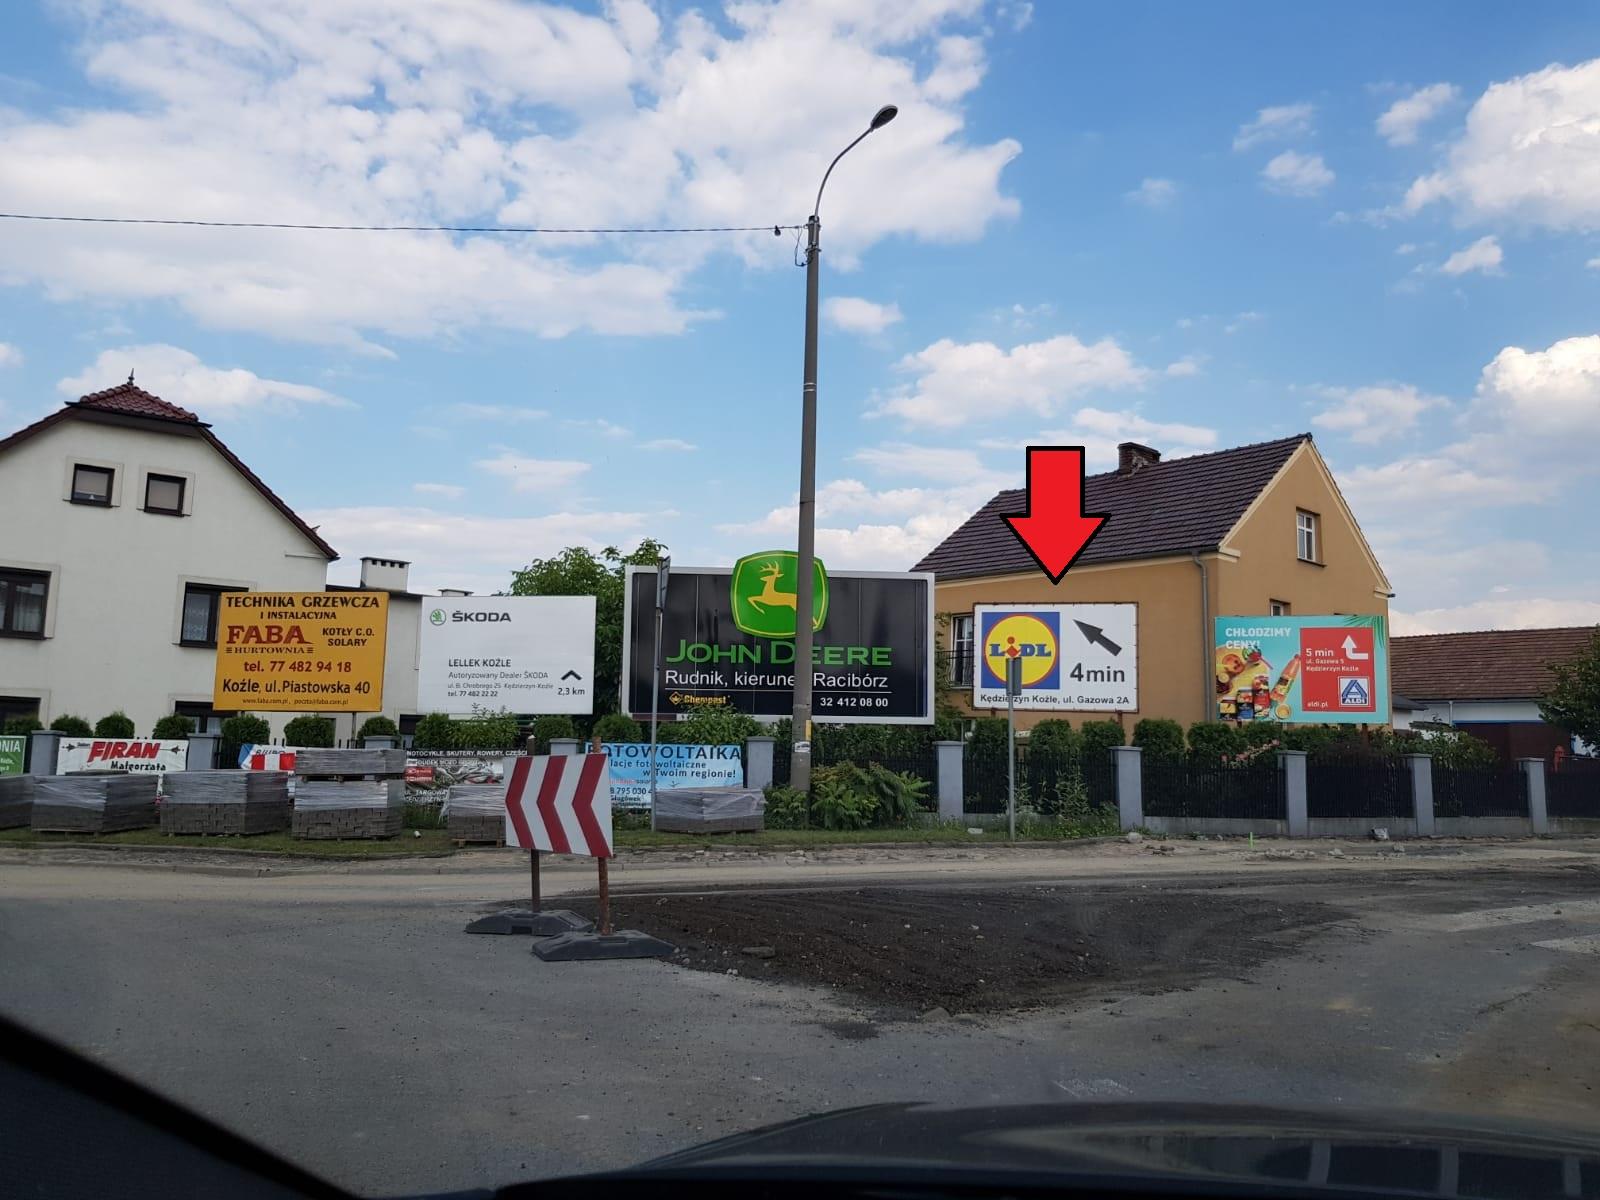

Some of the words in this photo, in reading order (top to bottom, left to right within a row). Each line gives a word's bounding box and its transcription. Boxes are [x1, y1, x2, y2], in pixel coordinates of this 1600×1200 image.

[227, 597, 295, 607] TECHNIKA
[302, 597, 379, 608] GRZEWCZA
[452, 611, 511, 622] ŠKODA
[226, 625, 316, 644] FABA
[322, 628, 352, 636] KOTŁY
[356, 628, 375, 637] C.O.
[1225, 628, 1291, 637] CHŁODZIMY
[1225, 641, 1261, 650] CENY!
[666, 640, 761, 664] JOHN
[1306, 648, 1312, 657] 5
[1315, 648, 1334, 656] min
[244, 662, 264, 672] tel.
[270, 661, 285, 672] 77
[289, 661, 312, 672] 482
[317, 662, 332, 672] 94
[337, 662, 351, 672] 18
[448, 659, 480, 667] LELLEK
[448, 672, 498, 680] Autoryzowany
[665, 670, 728, 687] Rudnik,
[735, 671, 795, 687] kierune
[813, 673, 888, 688] Racibórz
[223, 679, 261, 694] Koźle,
[355, 682, 370, 693] 40
[820, 698, 832, 706] 32
[837, 698, 856, 707] 412
[860, 698, 872, 707] 08
[875, 698, 888, 707] 00
[980, 694, 1029, 704] Kędzizyn
[1033, 695, 1060, 704] Koźle,
[1077, 696, 1114, 704] Gazowa
[1117, 696, 1129, 704] 2A
[87, 742, 161, 762] FIRAN
[111, 761, 166, 771] Małgorzata
[691, 769, 736, 779] regionie!
